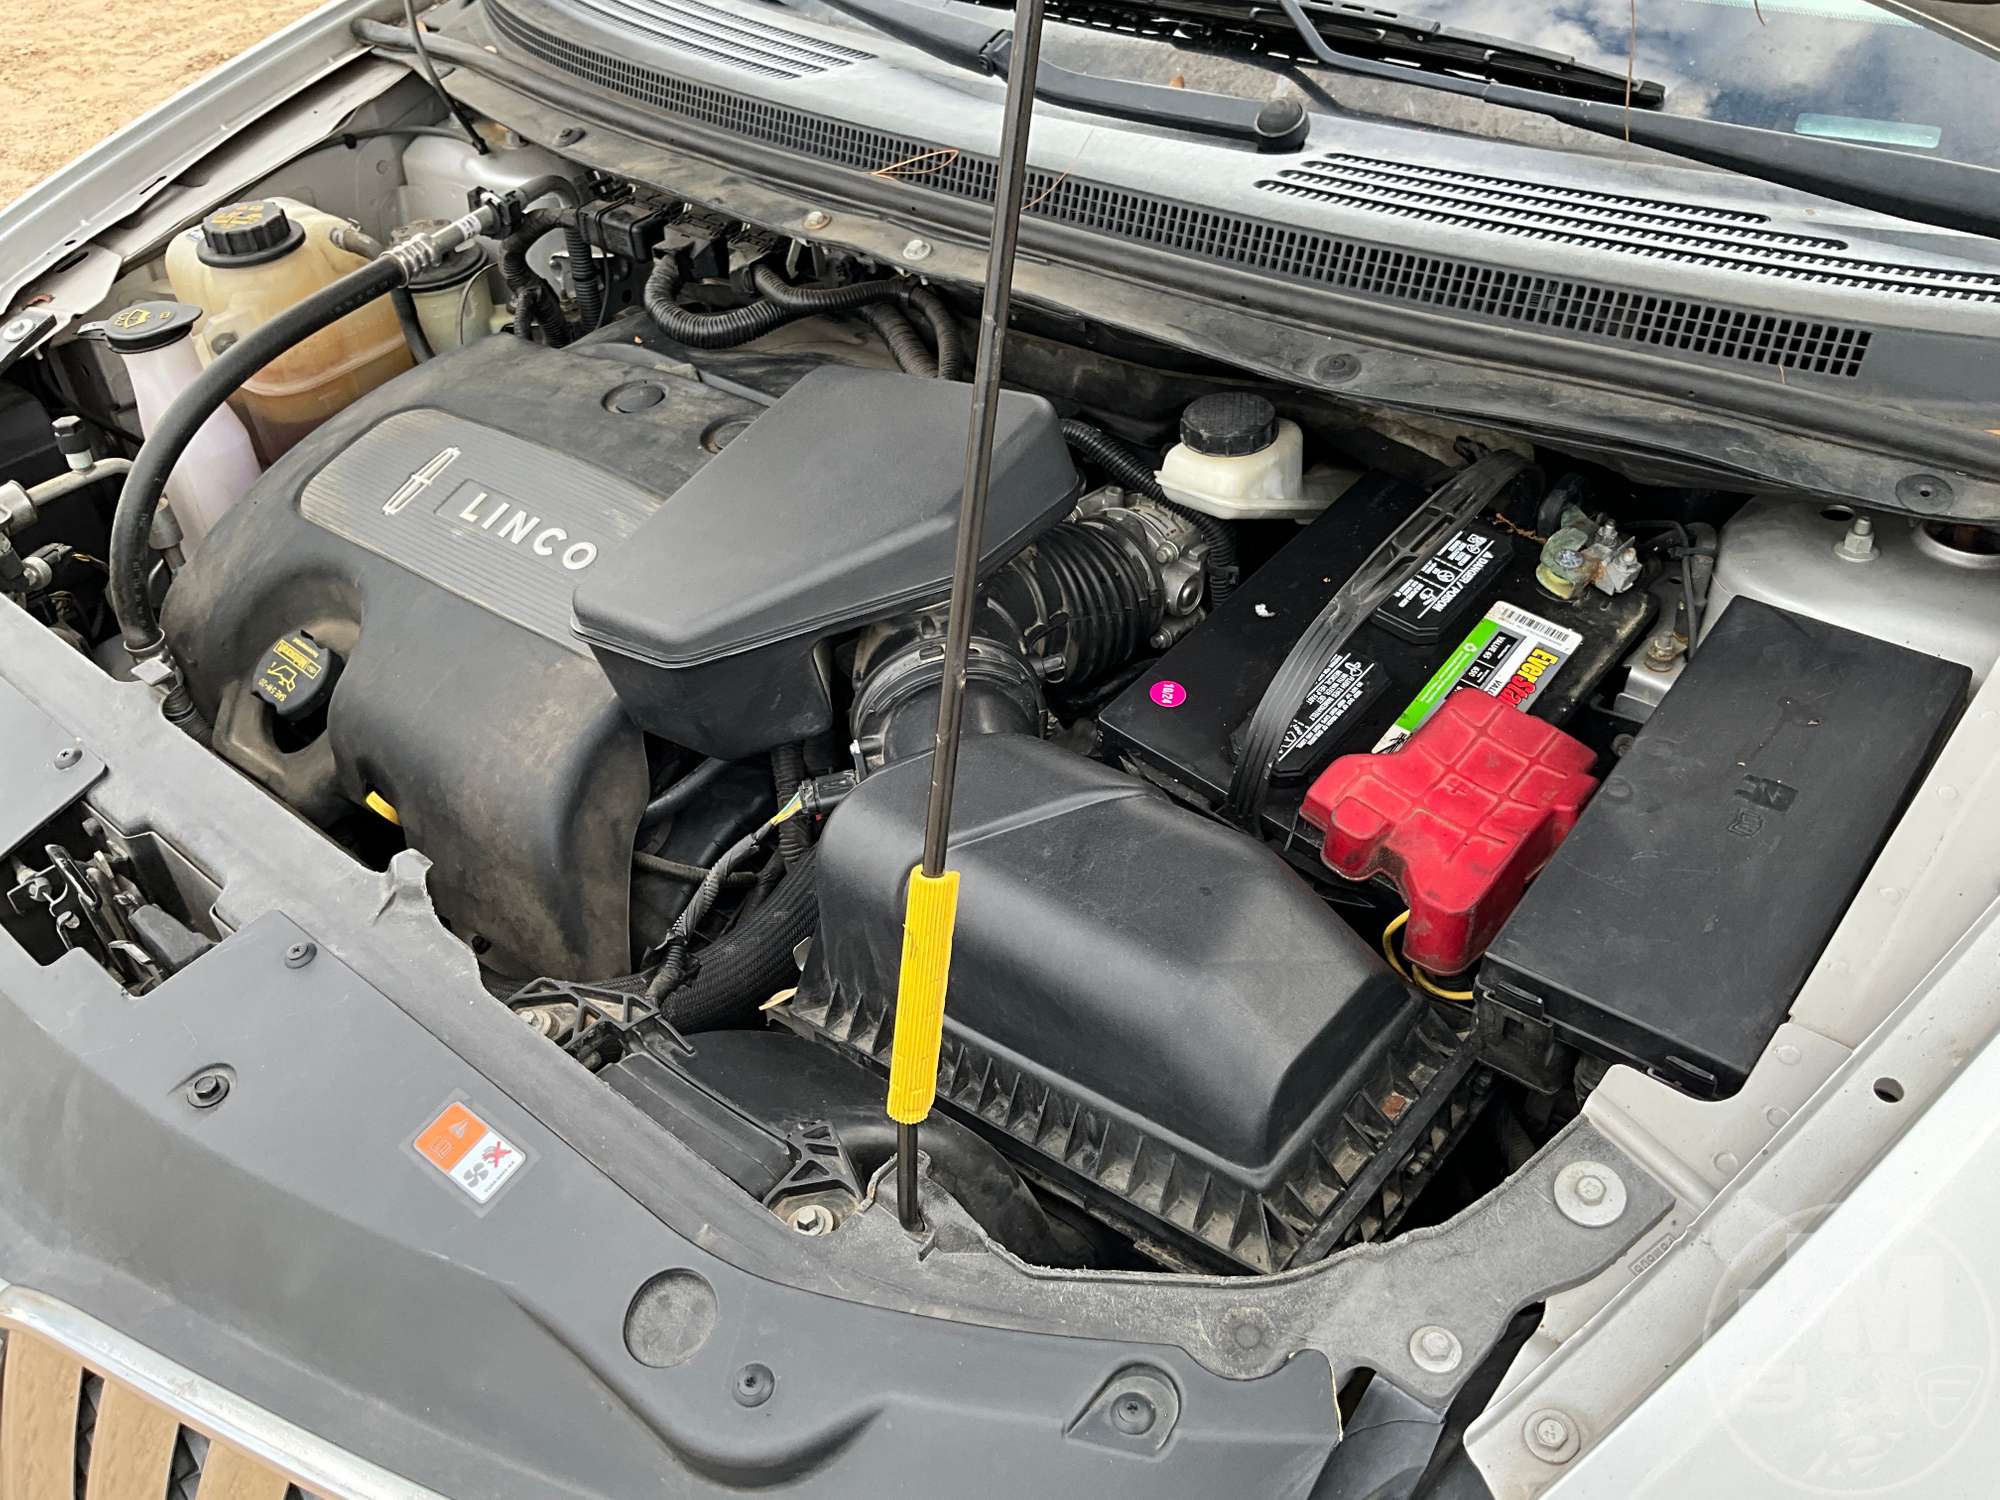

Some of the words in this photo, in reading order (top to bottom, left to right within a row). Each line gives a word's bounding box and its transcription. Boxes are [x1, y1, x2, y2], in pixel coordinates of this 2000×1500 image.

[1459, 556, 1488, 583] DANGER
[1432, 585, 1461, 612] POISON
[1488, 636, 1506, 653] VALUE
[1468, 666, 1480, 677] 650
[1161, 683, 1175, 704] 10/24
